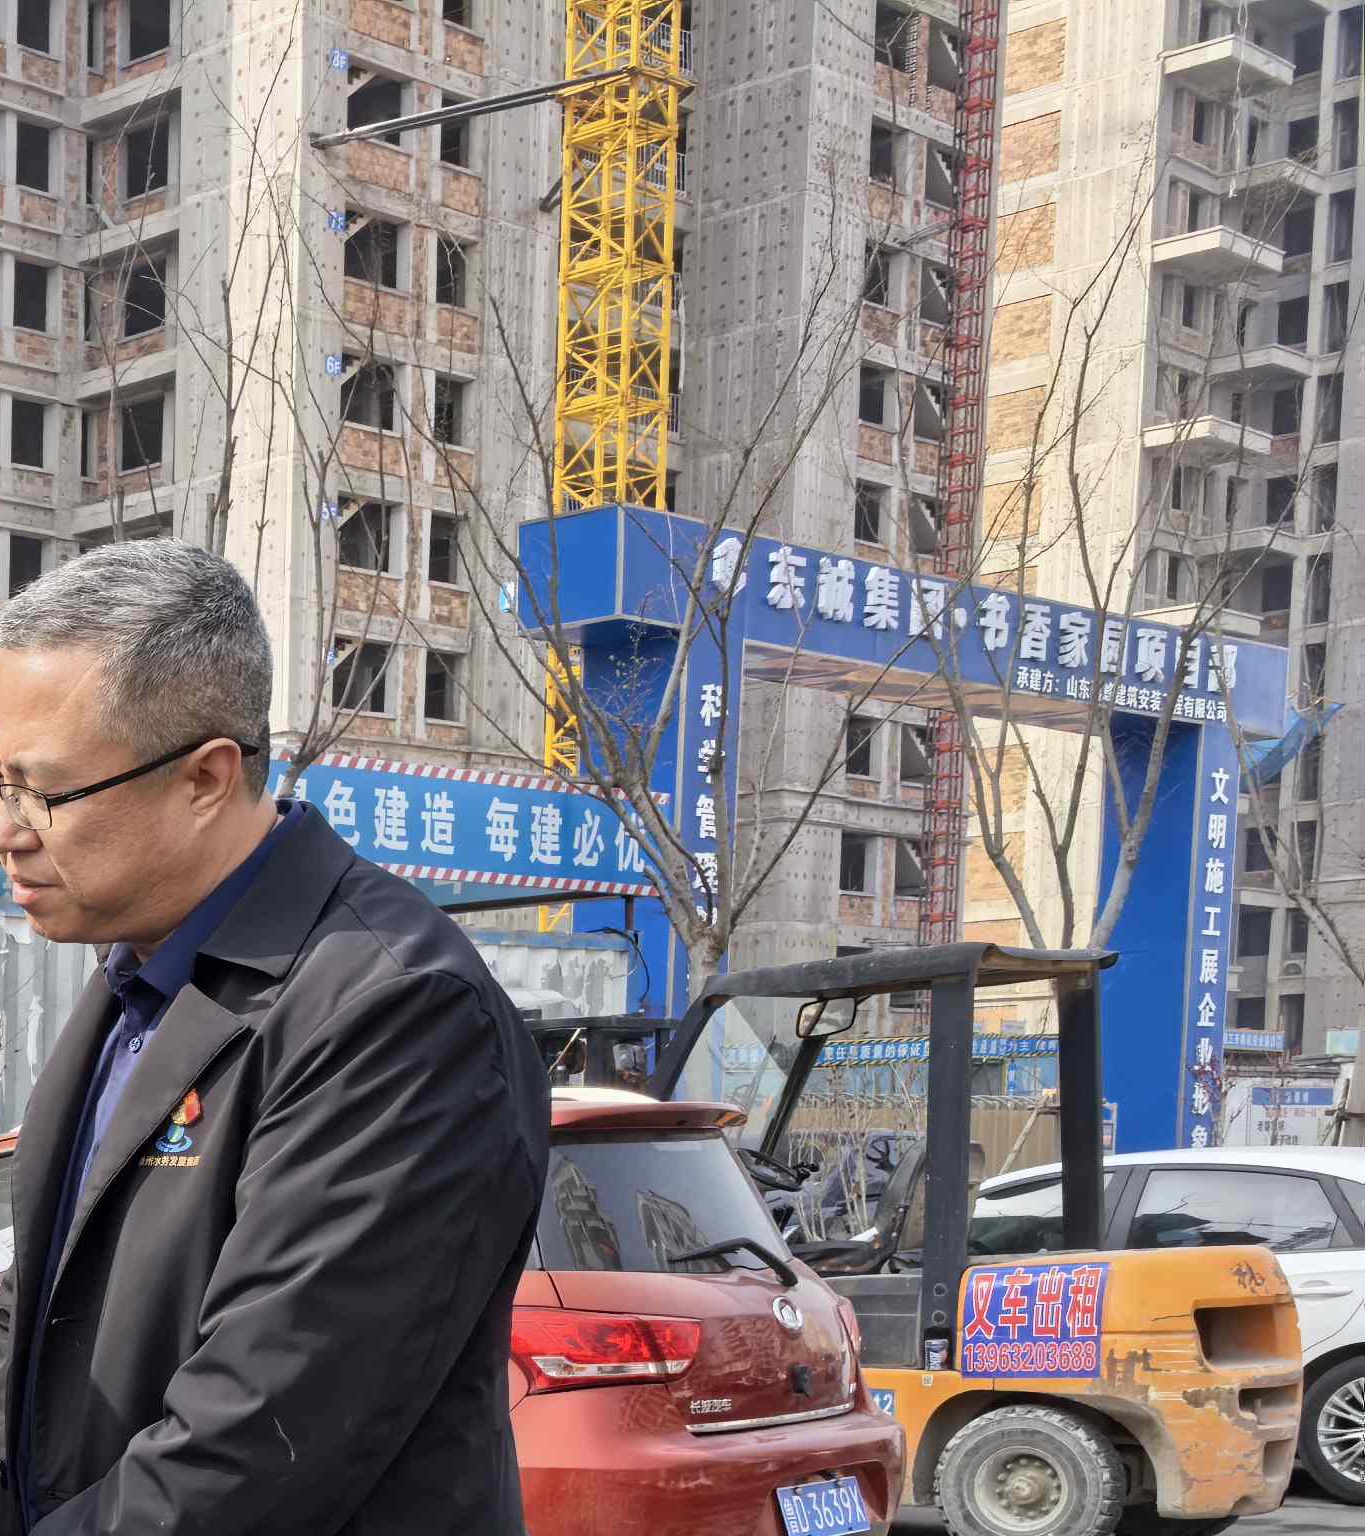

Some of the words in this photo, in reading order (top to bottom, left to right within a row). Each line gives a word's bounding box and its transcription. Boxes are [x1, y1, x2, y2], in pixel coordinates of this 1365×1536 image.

[273, 774, 455, 855] 色建造
[485, 797, 646, 873] 每建必优
[965, 1265, 1104, 1340] 叉车出租
[964, 1341, 1097, 1372] 13963203688
